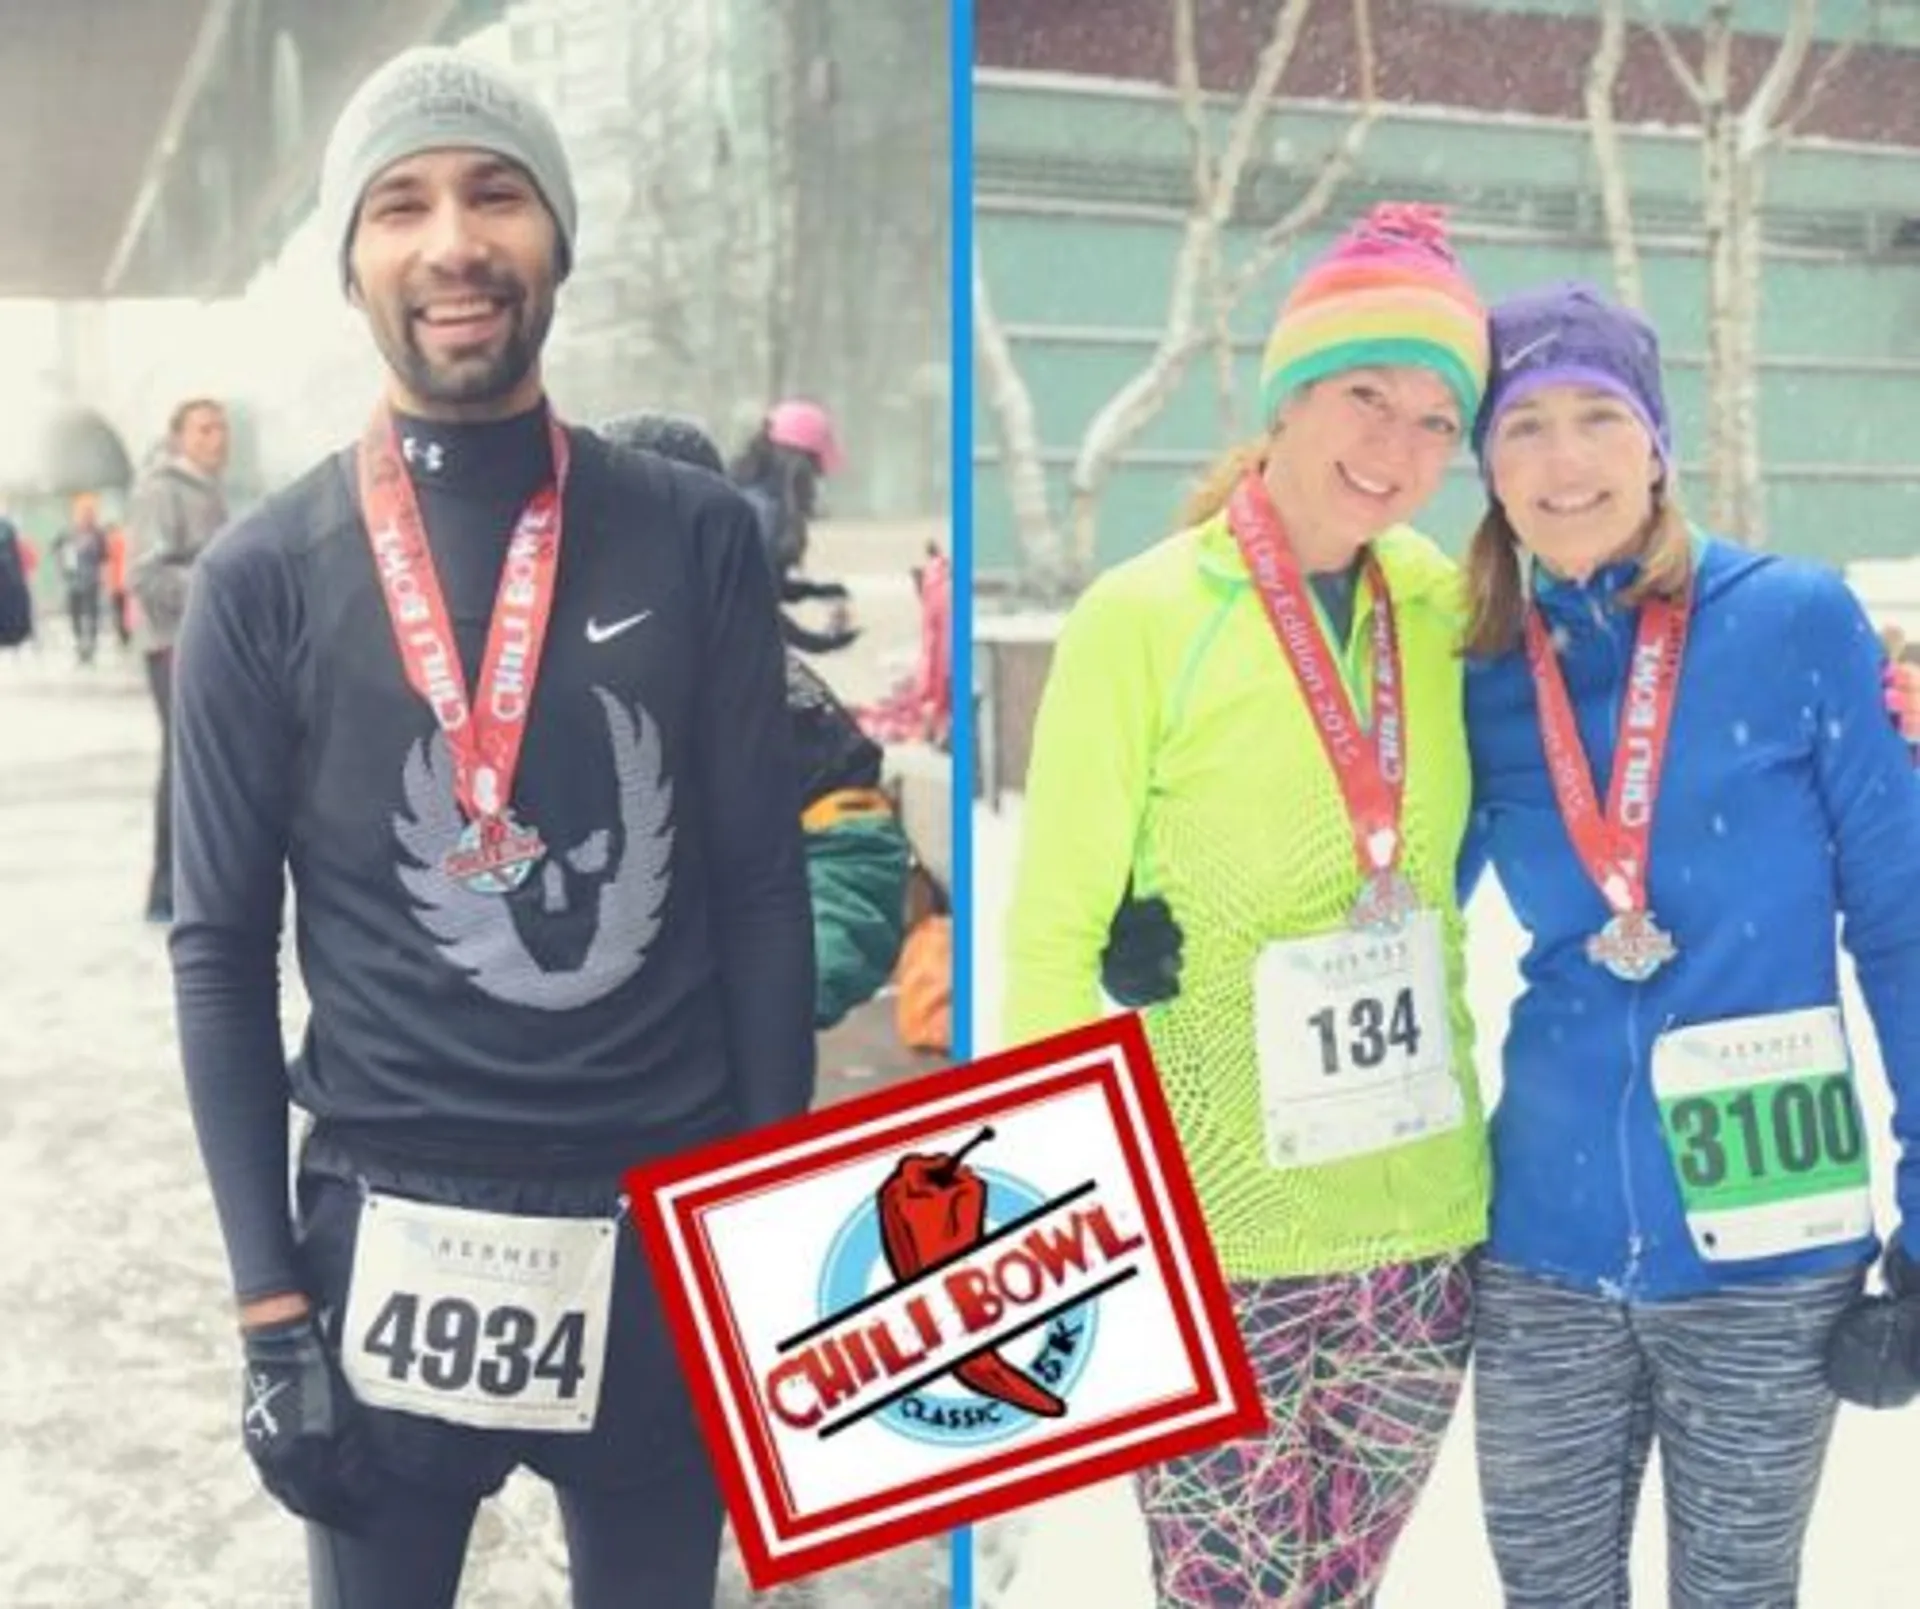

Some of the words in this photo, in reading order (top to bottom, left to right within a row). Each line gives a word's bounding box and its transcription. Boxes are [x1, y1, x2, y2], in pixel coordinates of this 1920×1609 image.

[375, 521, 429, 622] BOWL
[504, 509, 550, 607] BOWL
[409, 631, 466, 730] CHILI
[492, 617, 528, 722] CHILI
[1628, 636, 1664, 729] BOWL
[1620, 736, 1653, 828] CHILI
[1307, 986, 1421, 1076] 134
[1671, 1072, 1862, 1189] 3100
[363, 1289, 586, 1400] 4934
